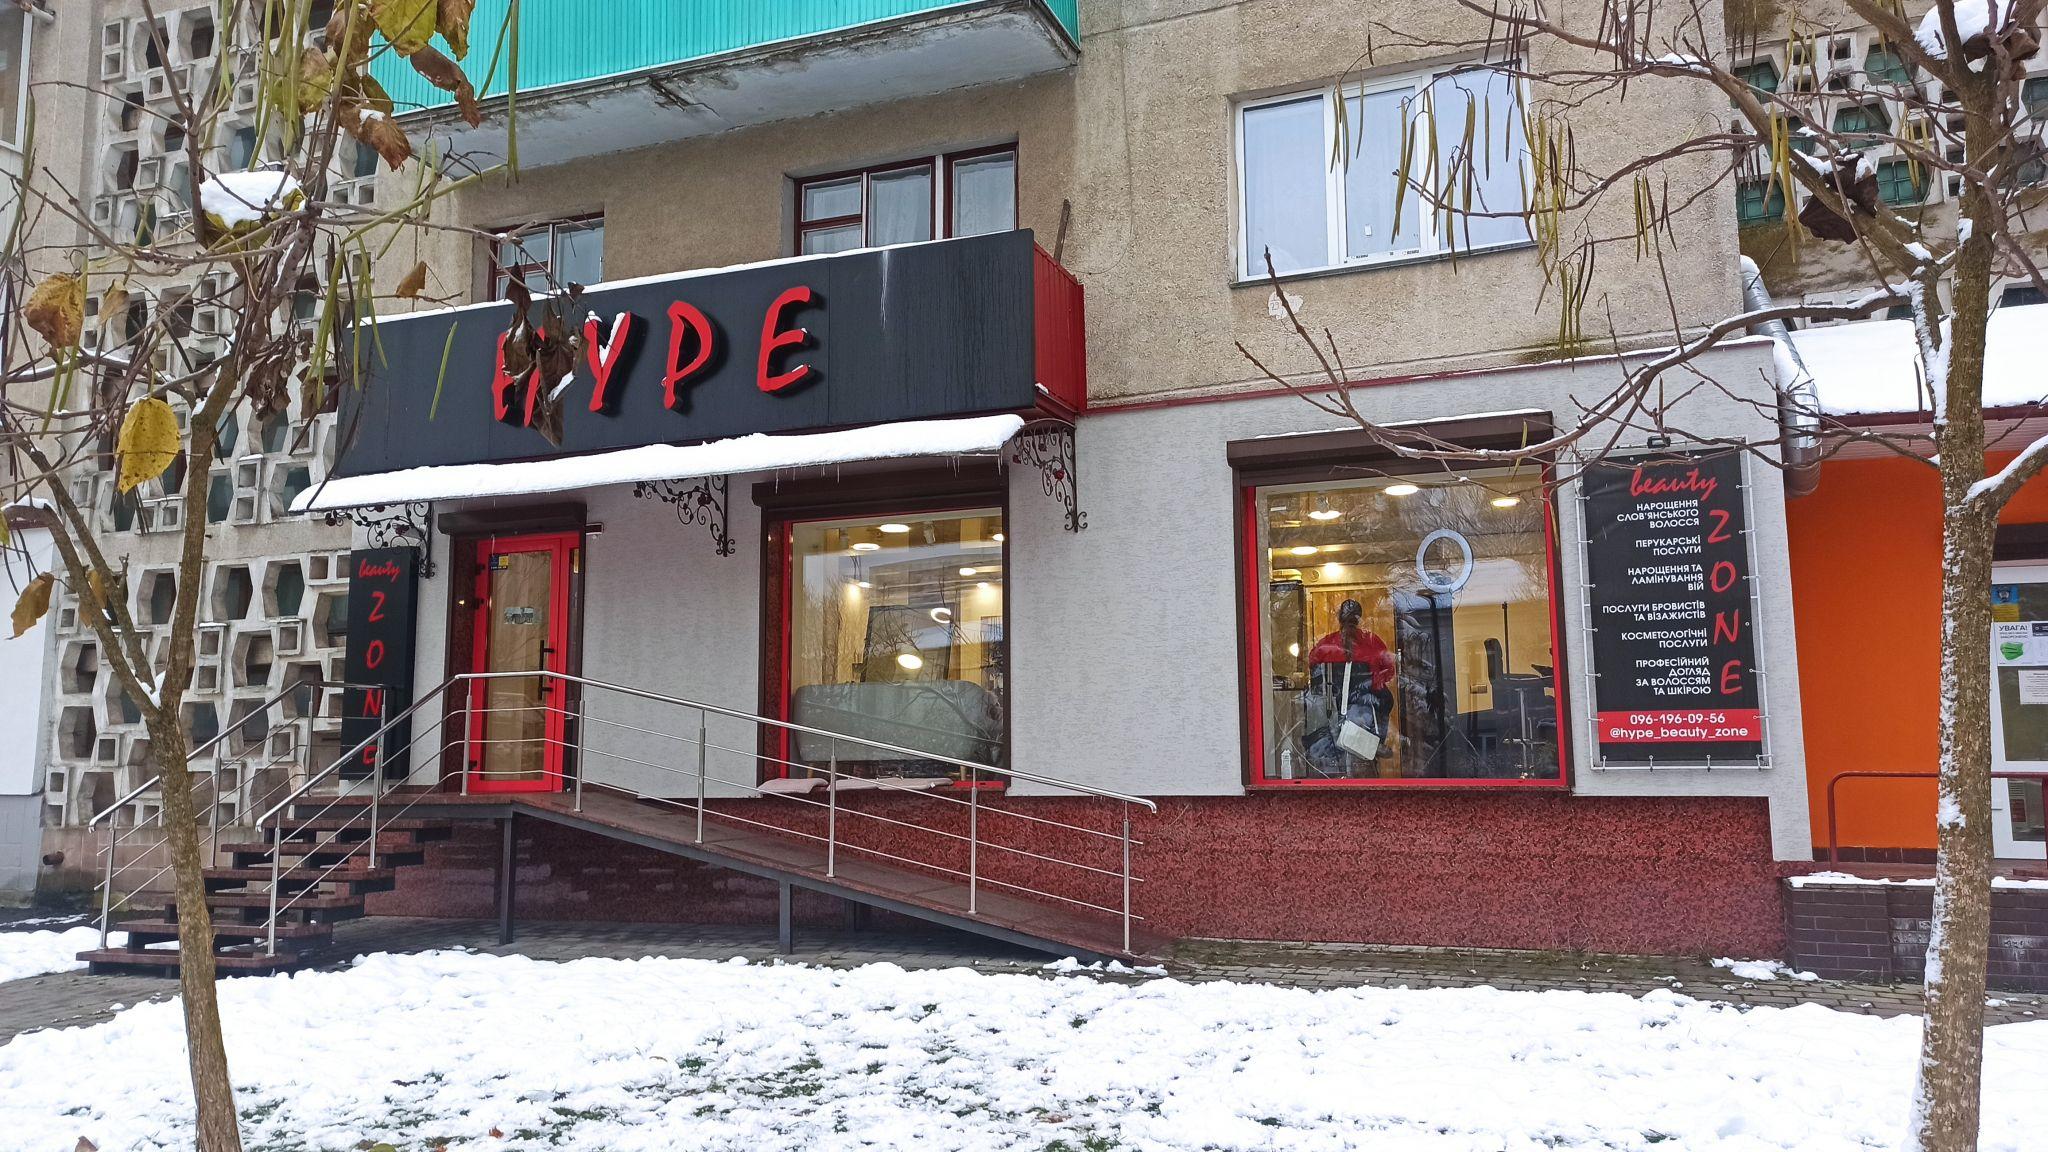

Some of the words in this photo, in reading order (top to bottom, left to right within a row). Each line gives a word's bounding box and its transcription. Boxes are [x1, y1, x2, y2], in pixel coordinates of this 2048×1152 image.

[1630, 467, 1718, 501] beauty
[1636, 499, 1698, 512] НАРОЩЕННЯ
[1616, 508, 1699, 522] СЛОВ'ЯНСЬКОГО
[1649, 518, 1700, 529] ВОЛОССЯ
[1635, 534, 1701, 548] ПЕРУКАРСЬКІ
[1653, 545, 1701, 556] ПОСЛУГИ
[358, 558, 401, 583] beauty
[1627, 564, 1690, 576] НАРОЩЕННЯ
[1691, 564, 1703, 573] ТА
[1631, 573, 1704, 585] ЛАМІНУВАННЯ
[1687, 580, 1704, 591] ВІЙ
[1602, 603, 1650, 614] ПОСЛУГИ
[1652, 600, 1705, 611] БРОВИСТІВ
[1708, 509, 1742, 694] ZONE
[1634, 612, 1645, 622] ТА
[1647, 609, 1706, 621] ВІЗАЖИСТІВ
[1998, 624, 2028, 632] УВАГА!
[1621, 628, 1707, 641] КОСМЕТОЛОГІЧНІ
[1659, 638, 1708, 649] ПОСЛУГИ
[1635, 656, 1710, 669] ПРОФЕСІЙНИЙ
[1668, 667, 1711, 677] ДОГЛЯД
[1635, 678, 1649, 687] ЗА
[1651, 676, 1711, 687] ВОЛОССЯМ
[1653, 687, 1666, 696] ТА
[1667, 685, 1712, 695] ШКІРОЮ
[1630, 713, 1726, 725] 096-196-09-56
[1610, 726, 1749, 739] @hype_beauty_zone
